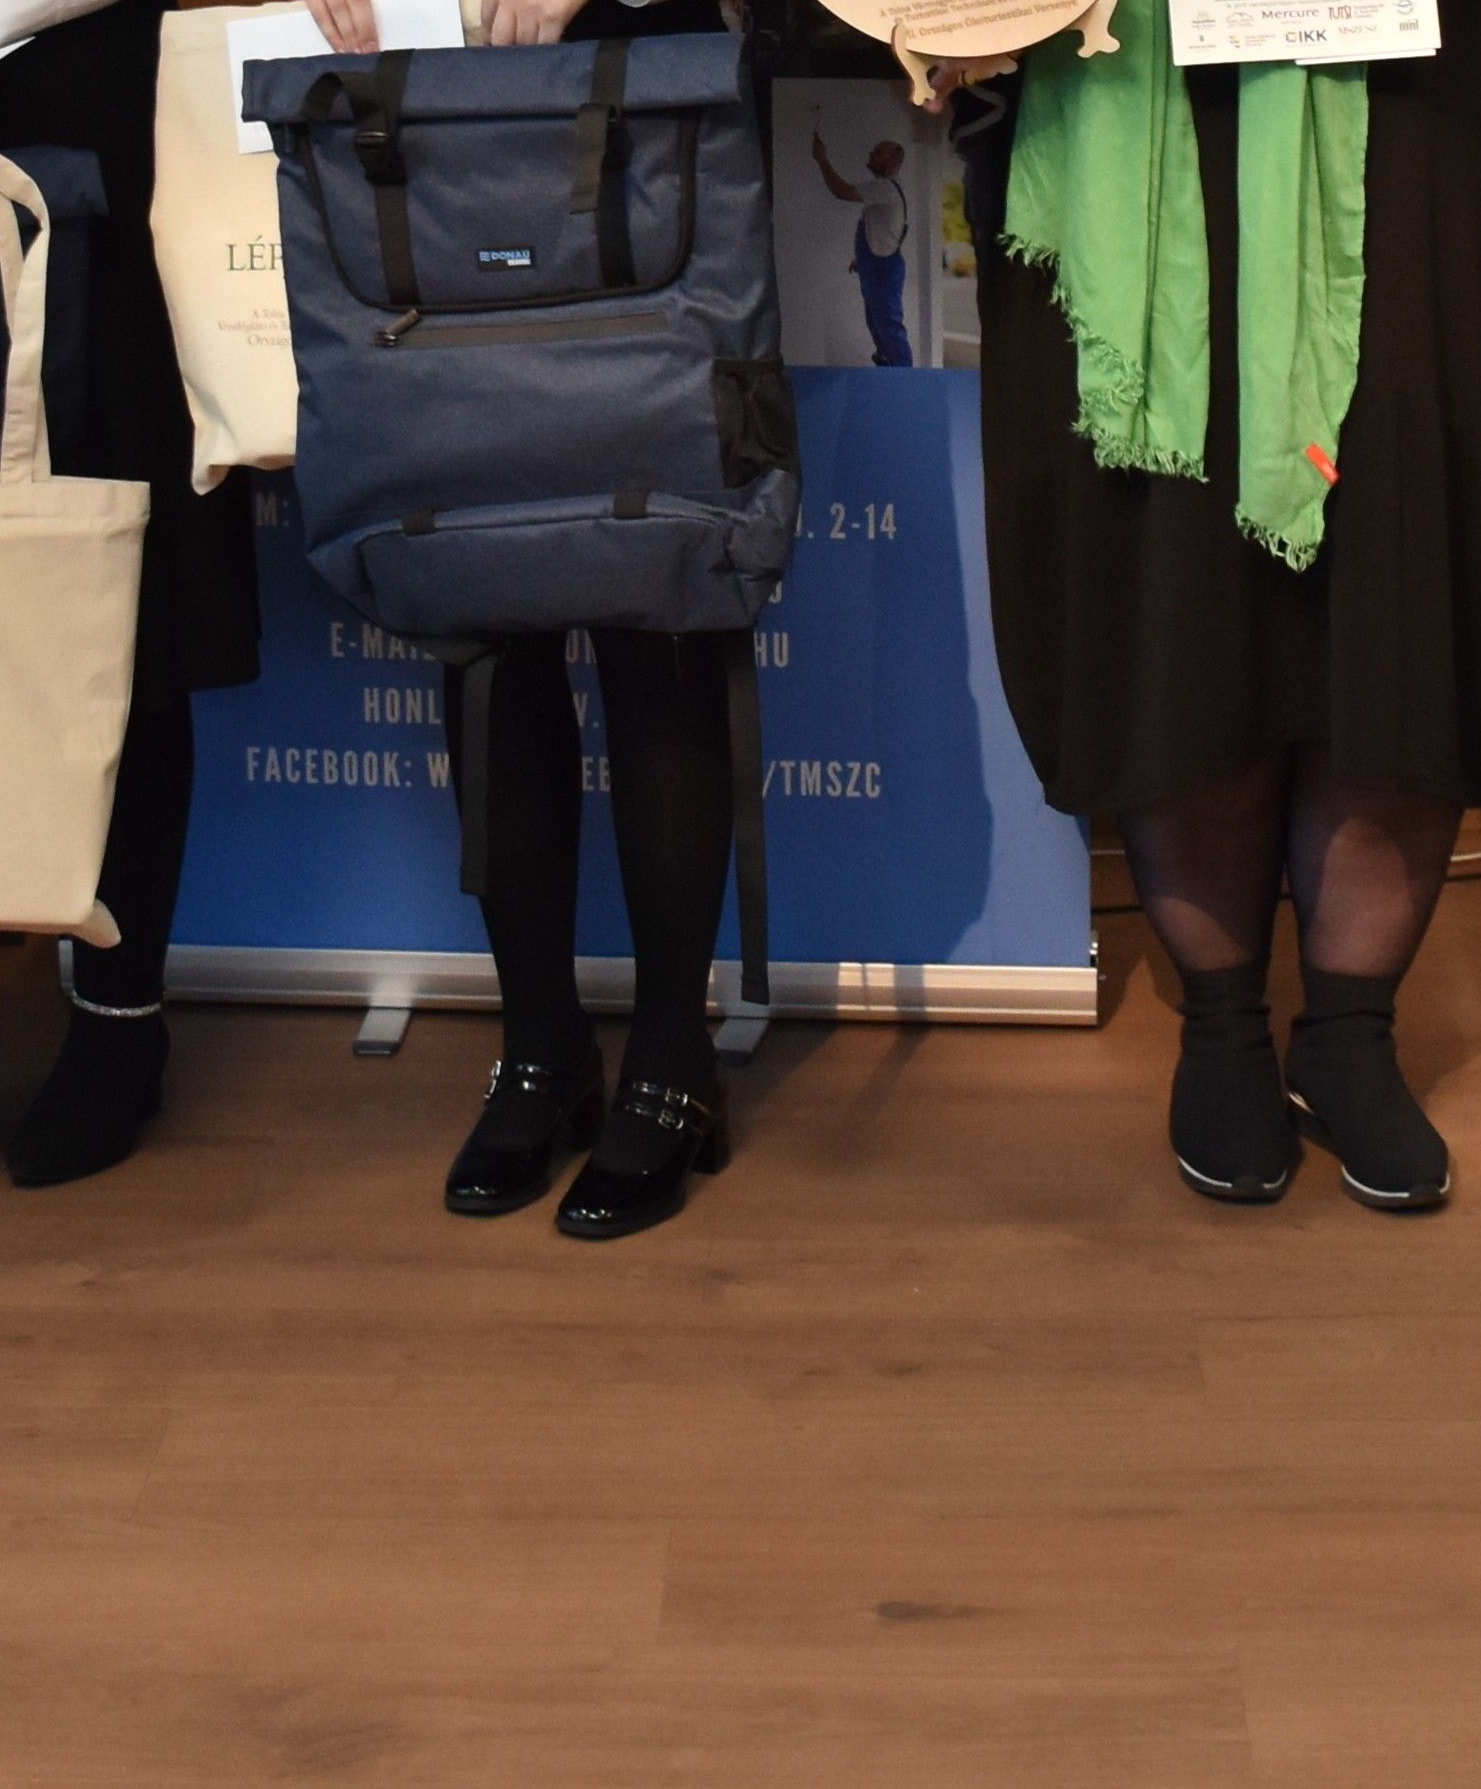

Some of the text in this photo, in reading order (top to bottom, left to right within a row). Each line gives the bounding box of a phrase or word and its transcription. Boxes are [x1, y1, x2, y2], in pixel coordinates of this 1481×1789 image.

[1262, 7, 1320, 21] Mercure
[829, 502, 898, 541] 2-14
[362, 687, 442, 726] HONL
[246, 746, 413, 788] FACEBOOK:
